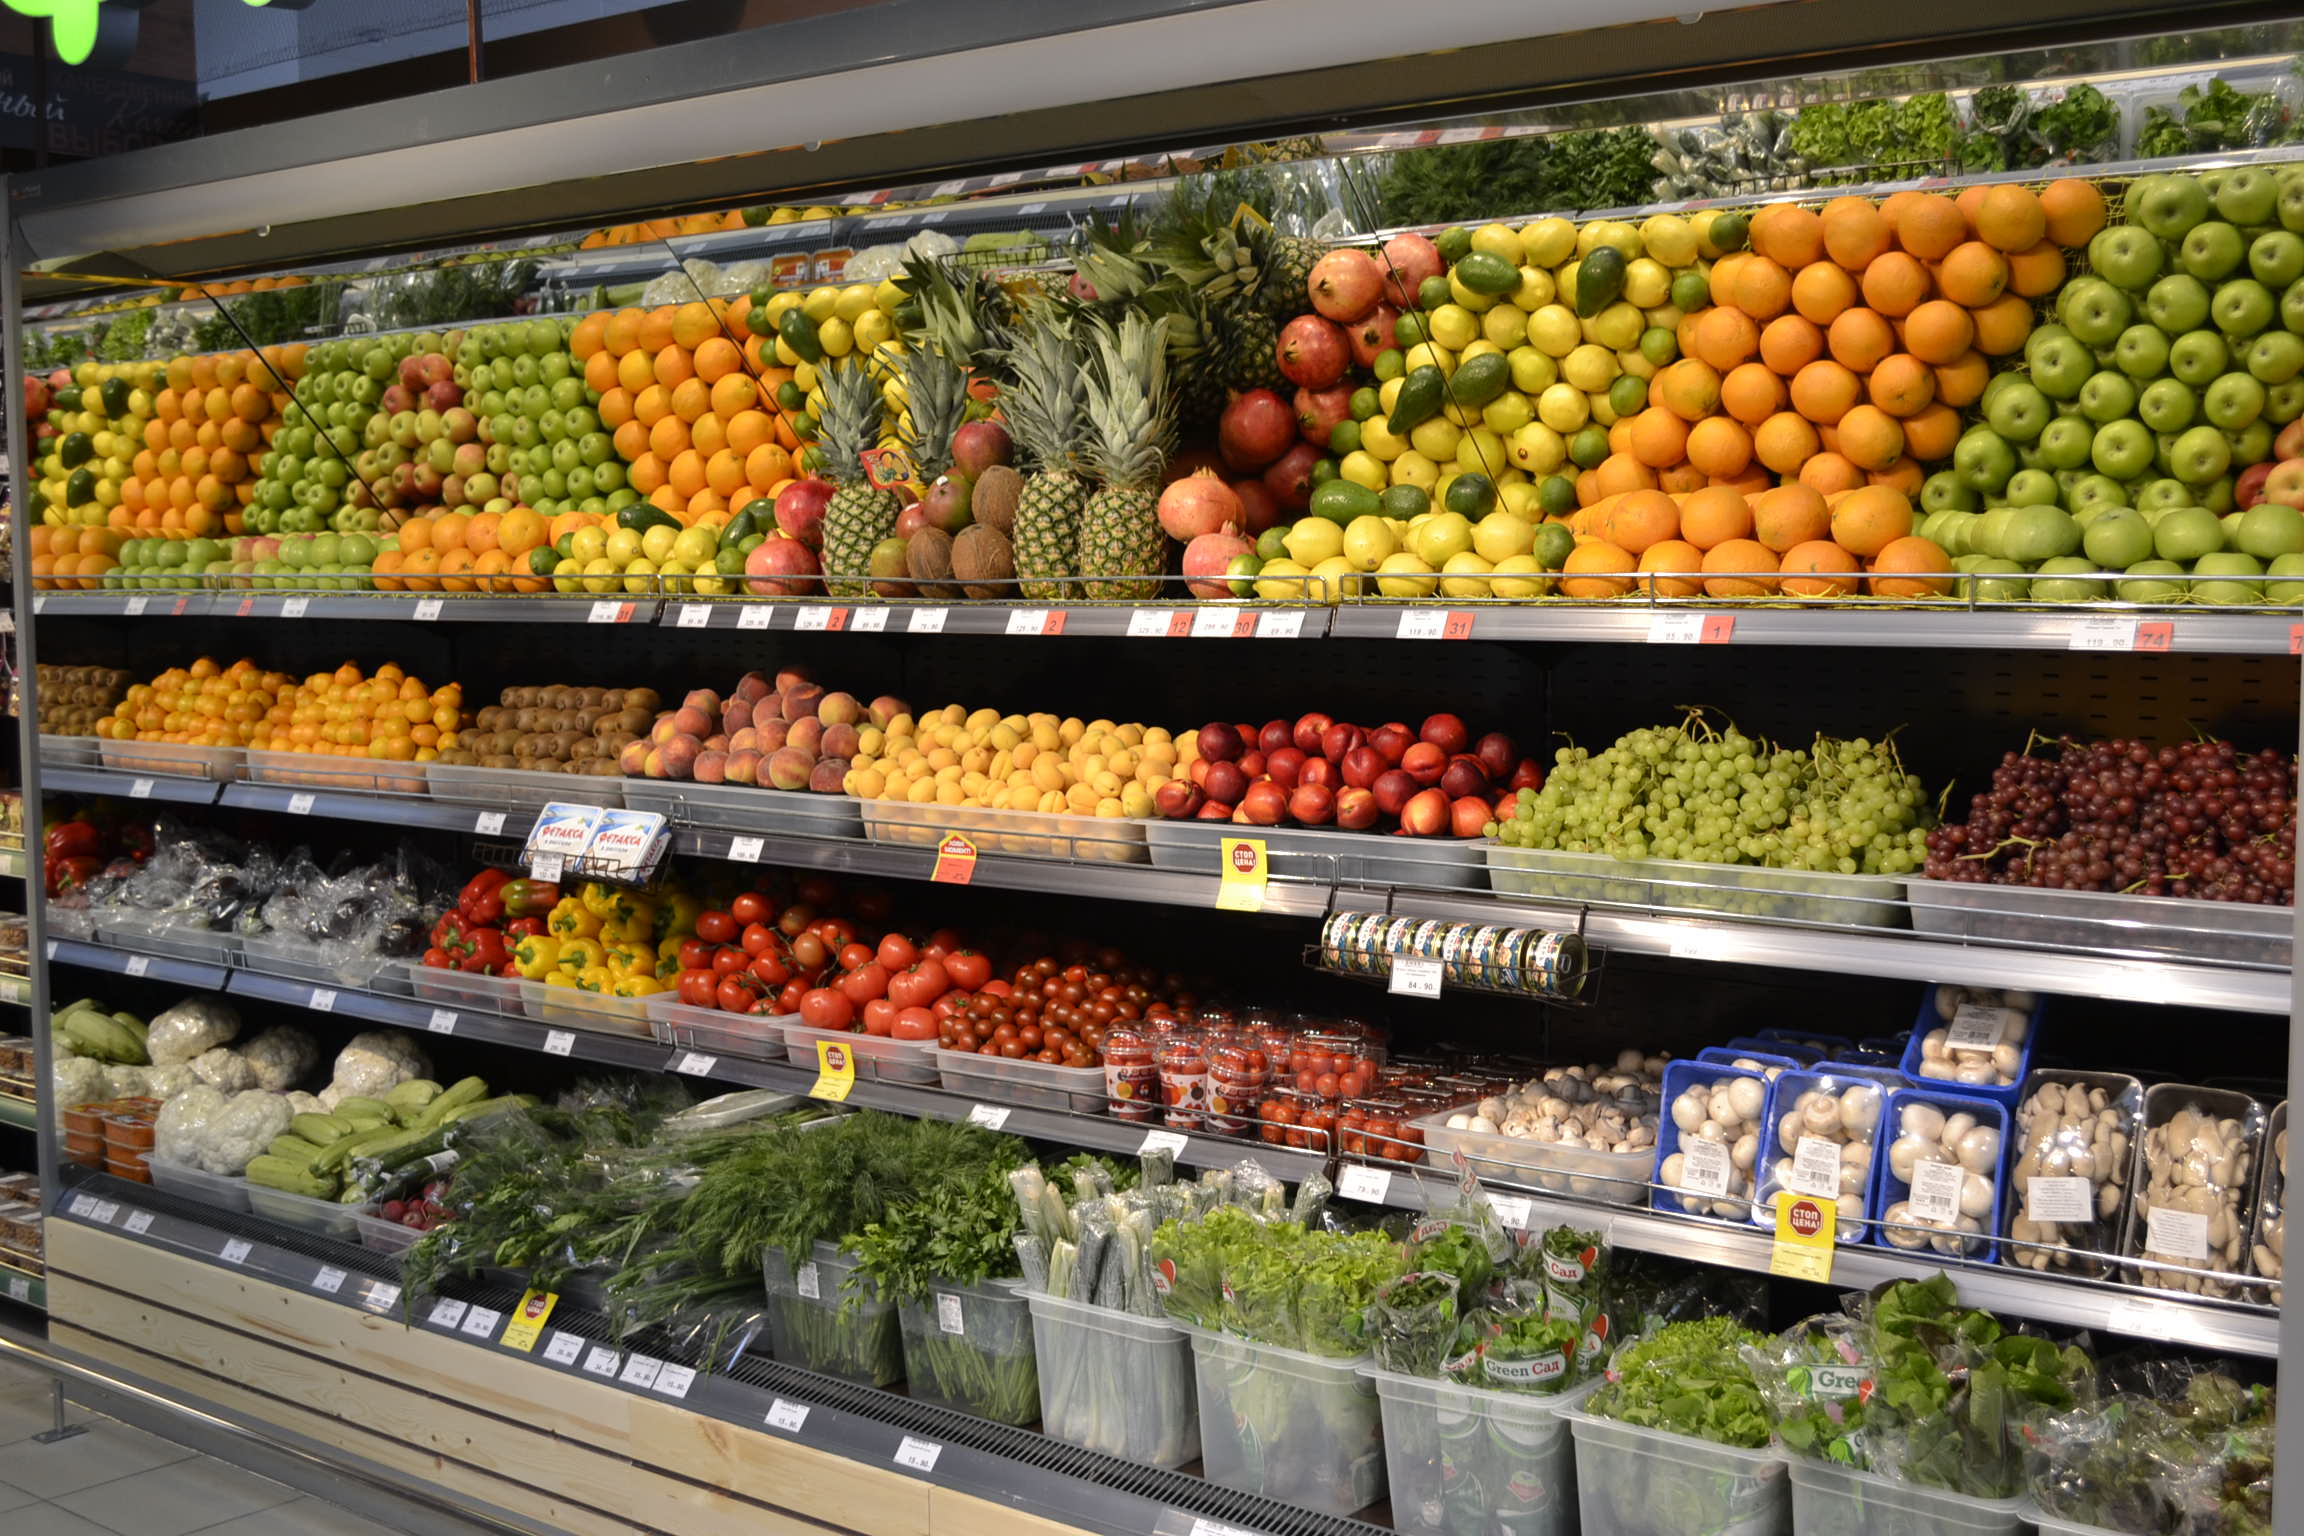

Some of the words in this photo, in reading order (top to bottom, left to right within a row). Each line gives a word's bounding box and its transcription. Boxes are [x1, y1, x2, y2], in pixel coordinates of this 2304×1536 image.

[831, 616, 840, 628] 2
[1048, 620, 1057, 632] 2
[1172, 621, 1188, 633] 12
[1234, 621, 1250, 634] 30
[1449, 622, 1467, 635] 31
[1713, 626, 1721, 639] 1
[2143, 633, 2164, 647] 74
[542, 826, 584, 840] ФЕТАКСА
[599, 831, 641, 846] ФЕТАКСА
[1234, 850, 1254, 858] СТОП
[1234, 858, 1256, 866] ЦЕНА!
[1793, 1208, 1819, 1220] СТОП
[1792, 1217, 1820, 1229] ЦЕНА!
[1551, 1263, 1577, 1279] Сад
[1486, 1360, 1529, 1378] Green
[1532, 1361, 1561, 1376] Сад
